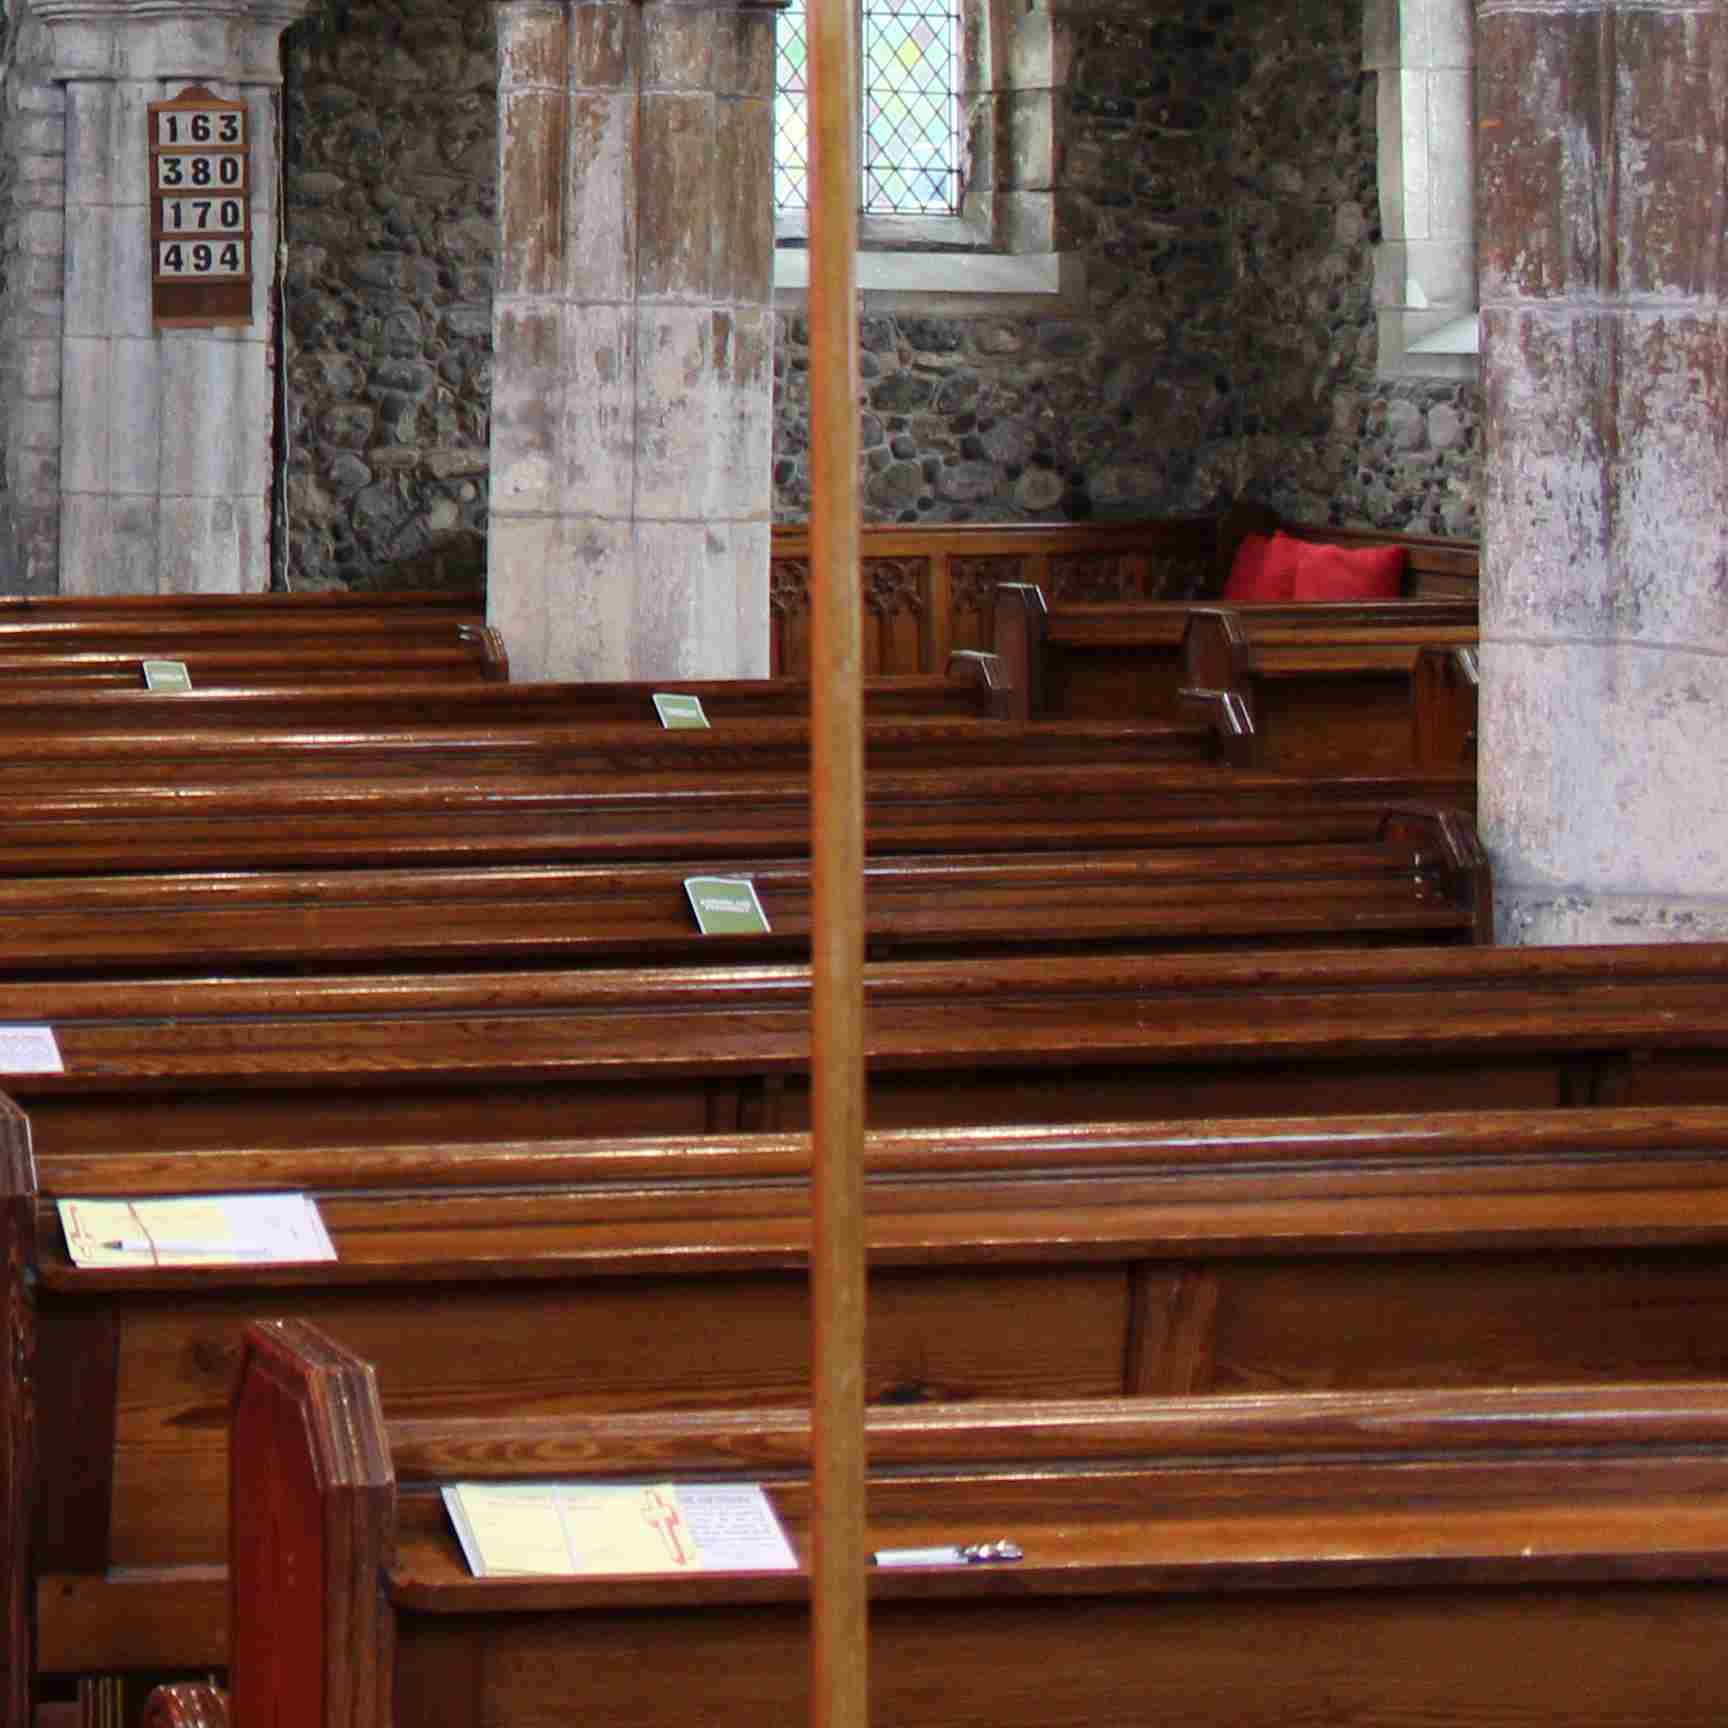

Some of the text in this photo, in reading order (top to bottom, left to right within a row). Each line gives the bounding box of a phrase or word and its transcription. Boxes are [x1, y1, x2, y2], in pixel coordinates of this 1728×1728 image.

[166, 114, 239, 143] 163
[163, 157, 239, 186] 380
[171, 200, 240, 229] 170
[164, 243, 239, 273] 494
